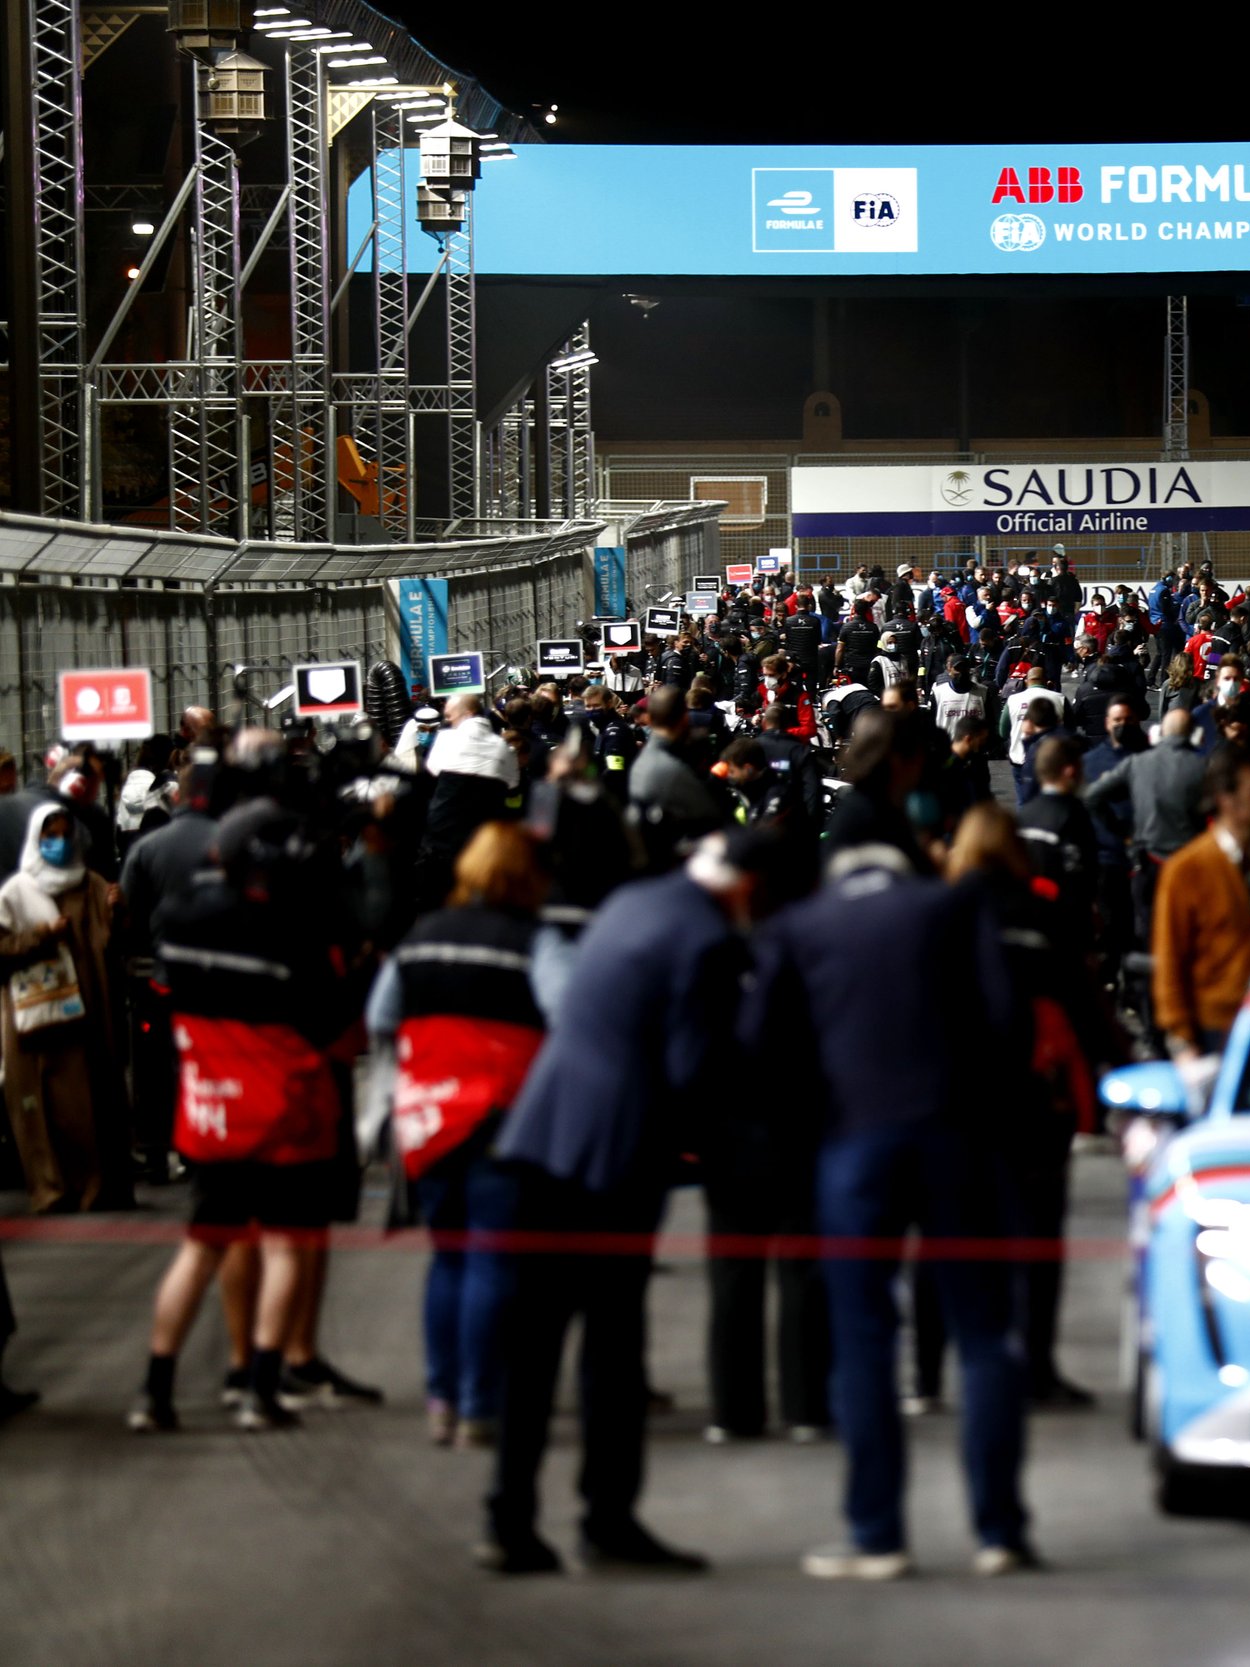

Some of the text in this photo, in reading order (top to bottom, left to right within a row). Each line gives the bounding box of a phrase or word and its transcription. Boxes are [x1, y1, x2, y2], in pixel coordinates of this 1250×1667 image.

[991, 167, 1084, 204] ABB
[766, 220, 824, 230] FORMULA E
[1053, 222, 1148, 241] WORLD
[983, 466, 1203, 506] SAUDIA
[996, 512, 1148, 533] Official Airline
[409, 591, 423, 601] E
[409, 604, 423, 679] FORMULA
